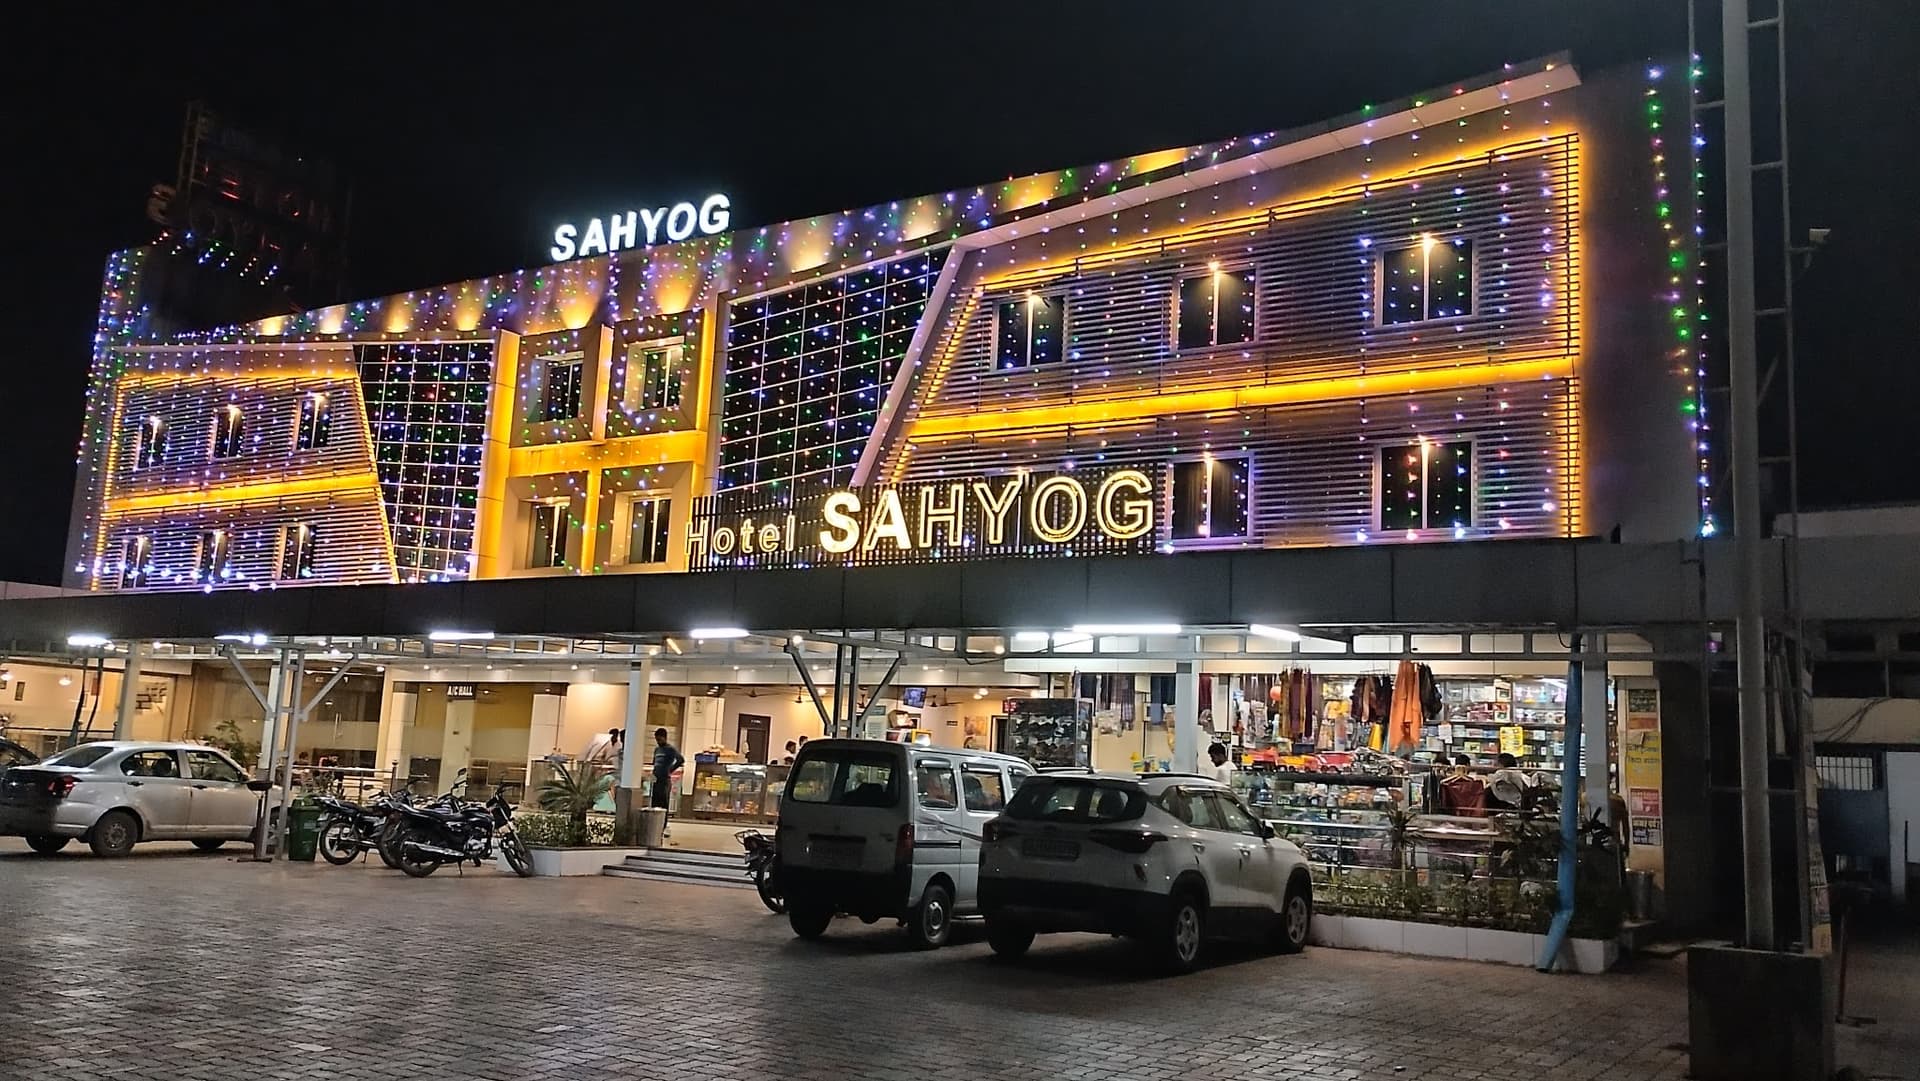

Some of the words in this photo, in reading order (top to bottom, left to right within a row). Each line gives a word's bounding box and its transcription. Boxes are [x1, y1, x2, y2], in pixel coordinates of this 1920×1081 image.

[551, 194, 731, 262] SAHYOG
[684, 514, 796, 555] Hotel
[819, 470, 1154, 555] SAHYOG
[458, 685, 473, 696] HALL
